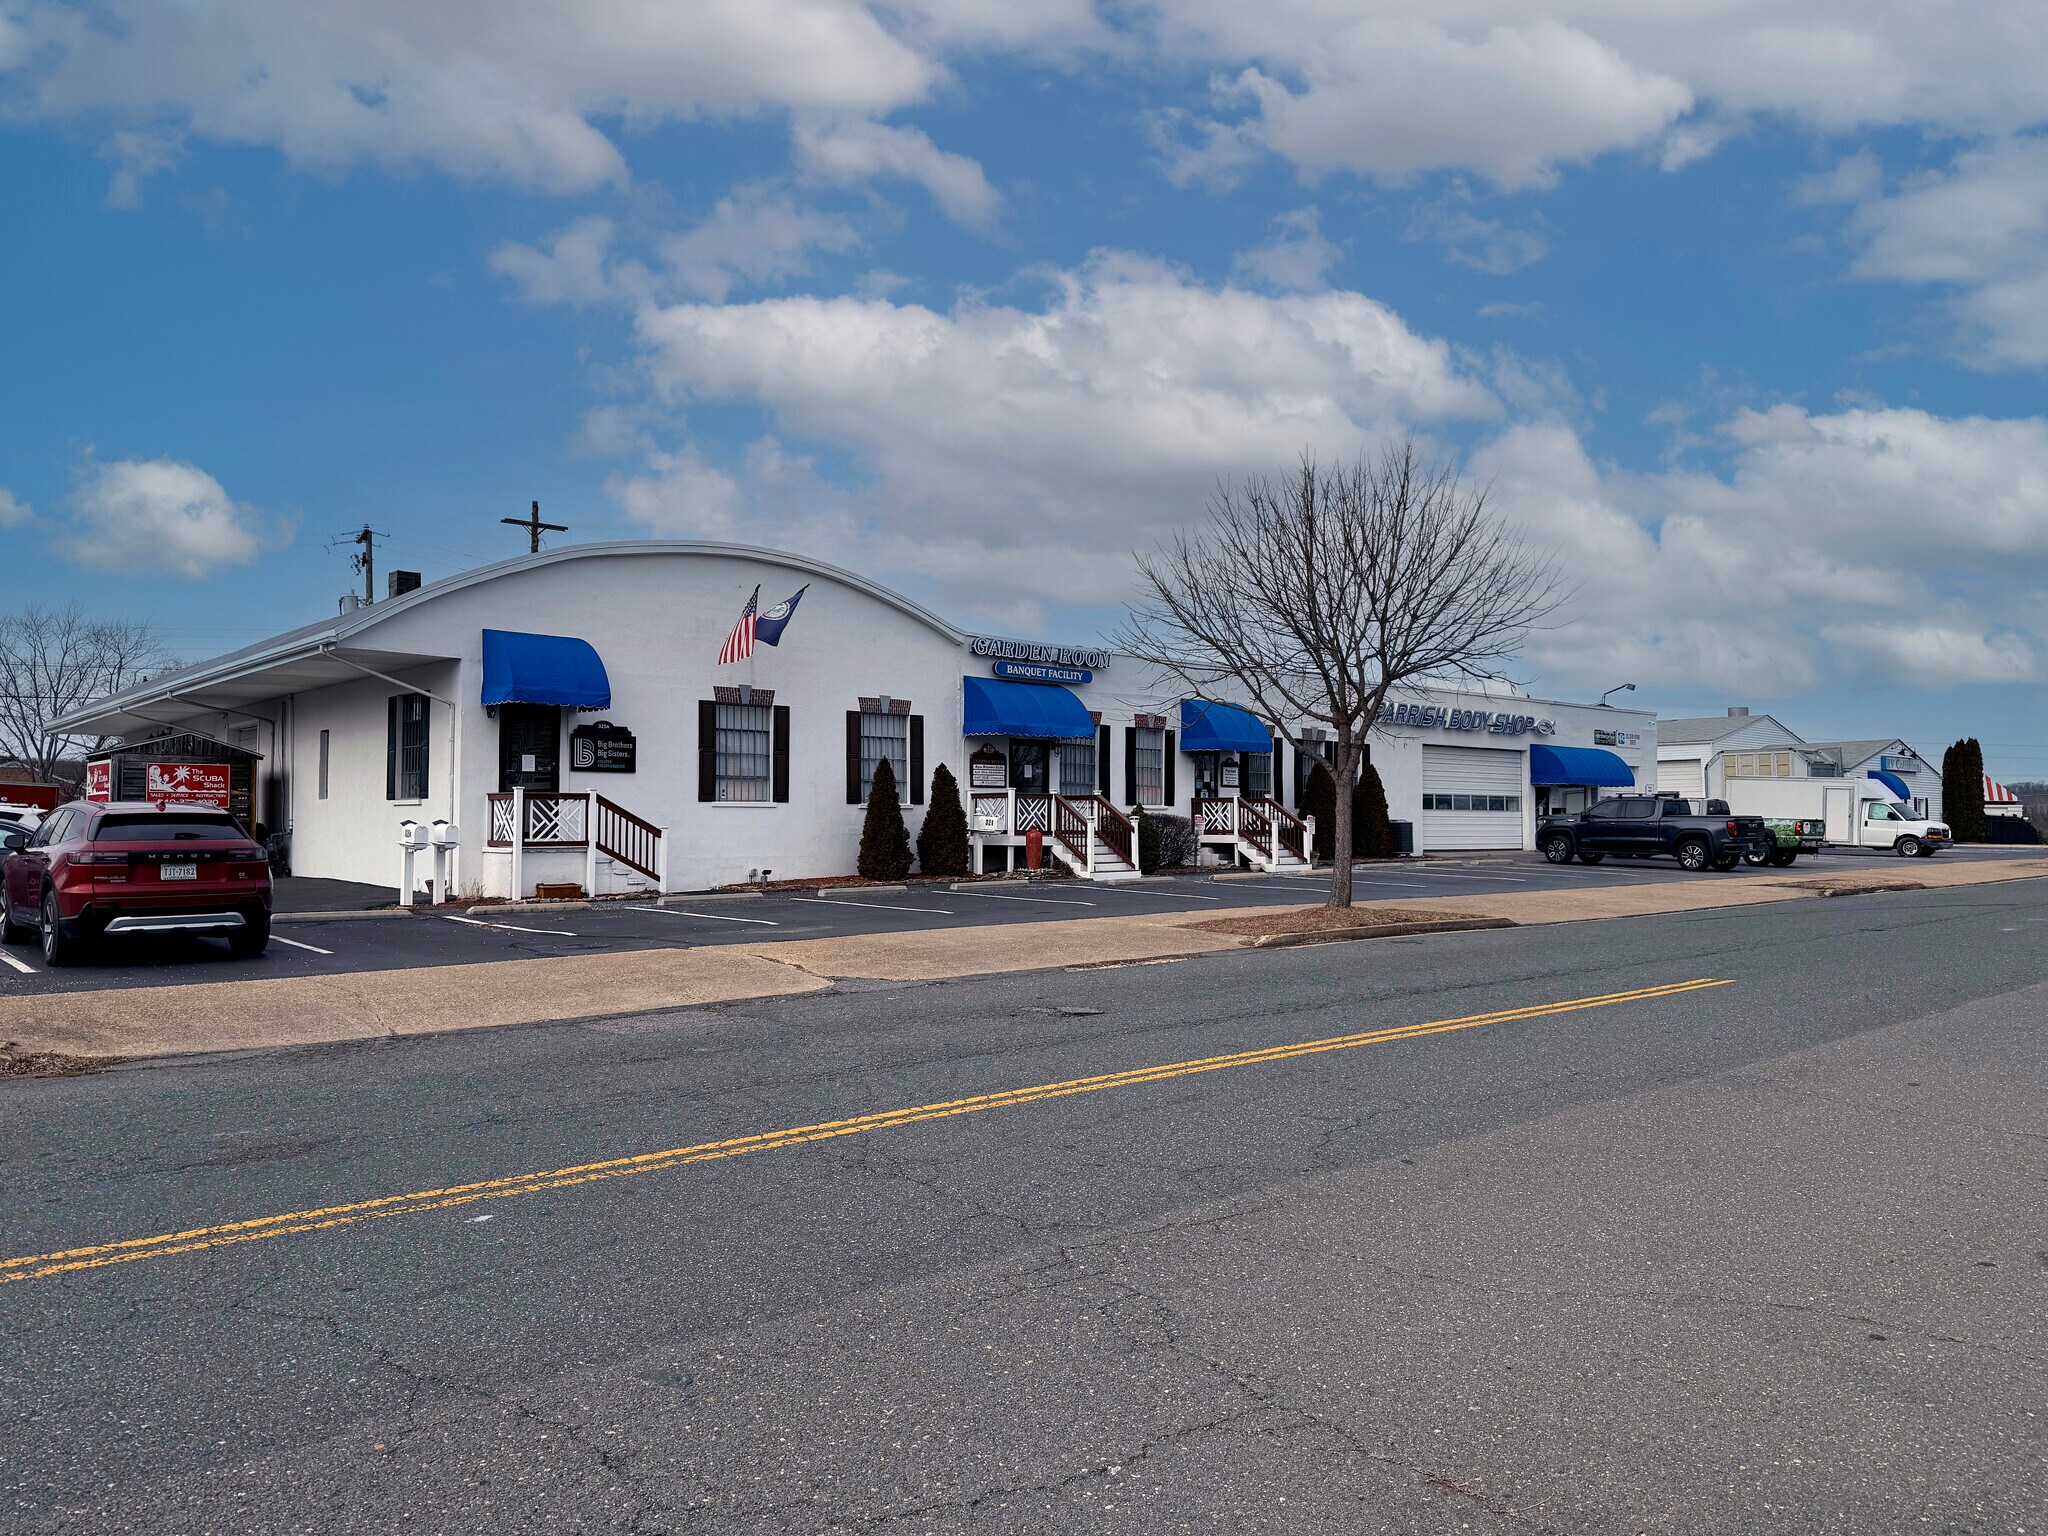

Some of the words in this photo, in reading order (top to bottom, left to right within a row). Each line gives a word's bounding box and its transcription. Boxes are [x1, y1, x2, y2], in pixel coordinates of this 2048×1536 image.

[973, 637, 1054, 661] GARDEN
[1059, 648, 1112, 668] ROOM
[1006, 664, 1047, 677] BANQUET
[1048, 669, 1084, 681] FACILITY
[1376, 702, 1448, 727] PARRISH
[1449, 708, 1491, 731] BODY
[1493, 714, 1535, 734] SHOP
[597, 740, 608, 750] Big
[608, 740, 633, 749] Brothers
[597, 749, 608, 759] Big
[163, 867, 195, 877] TJT-7182
